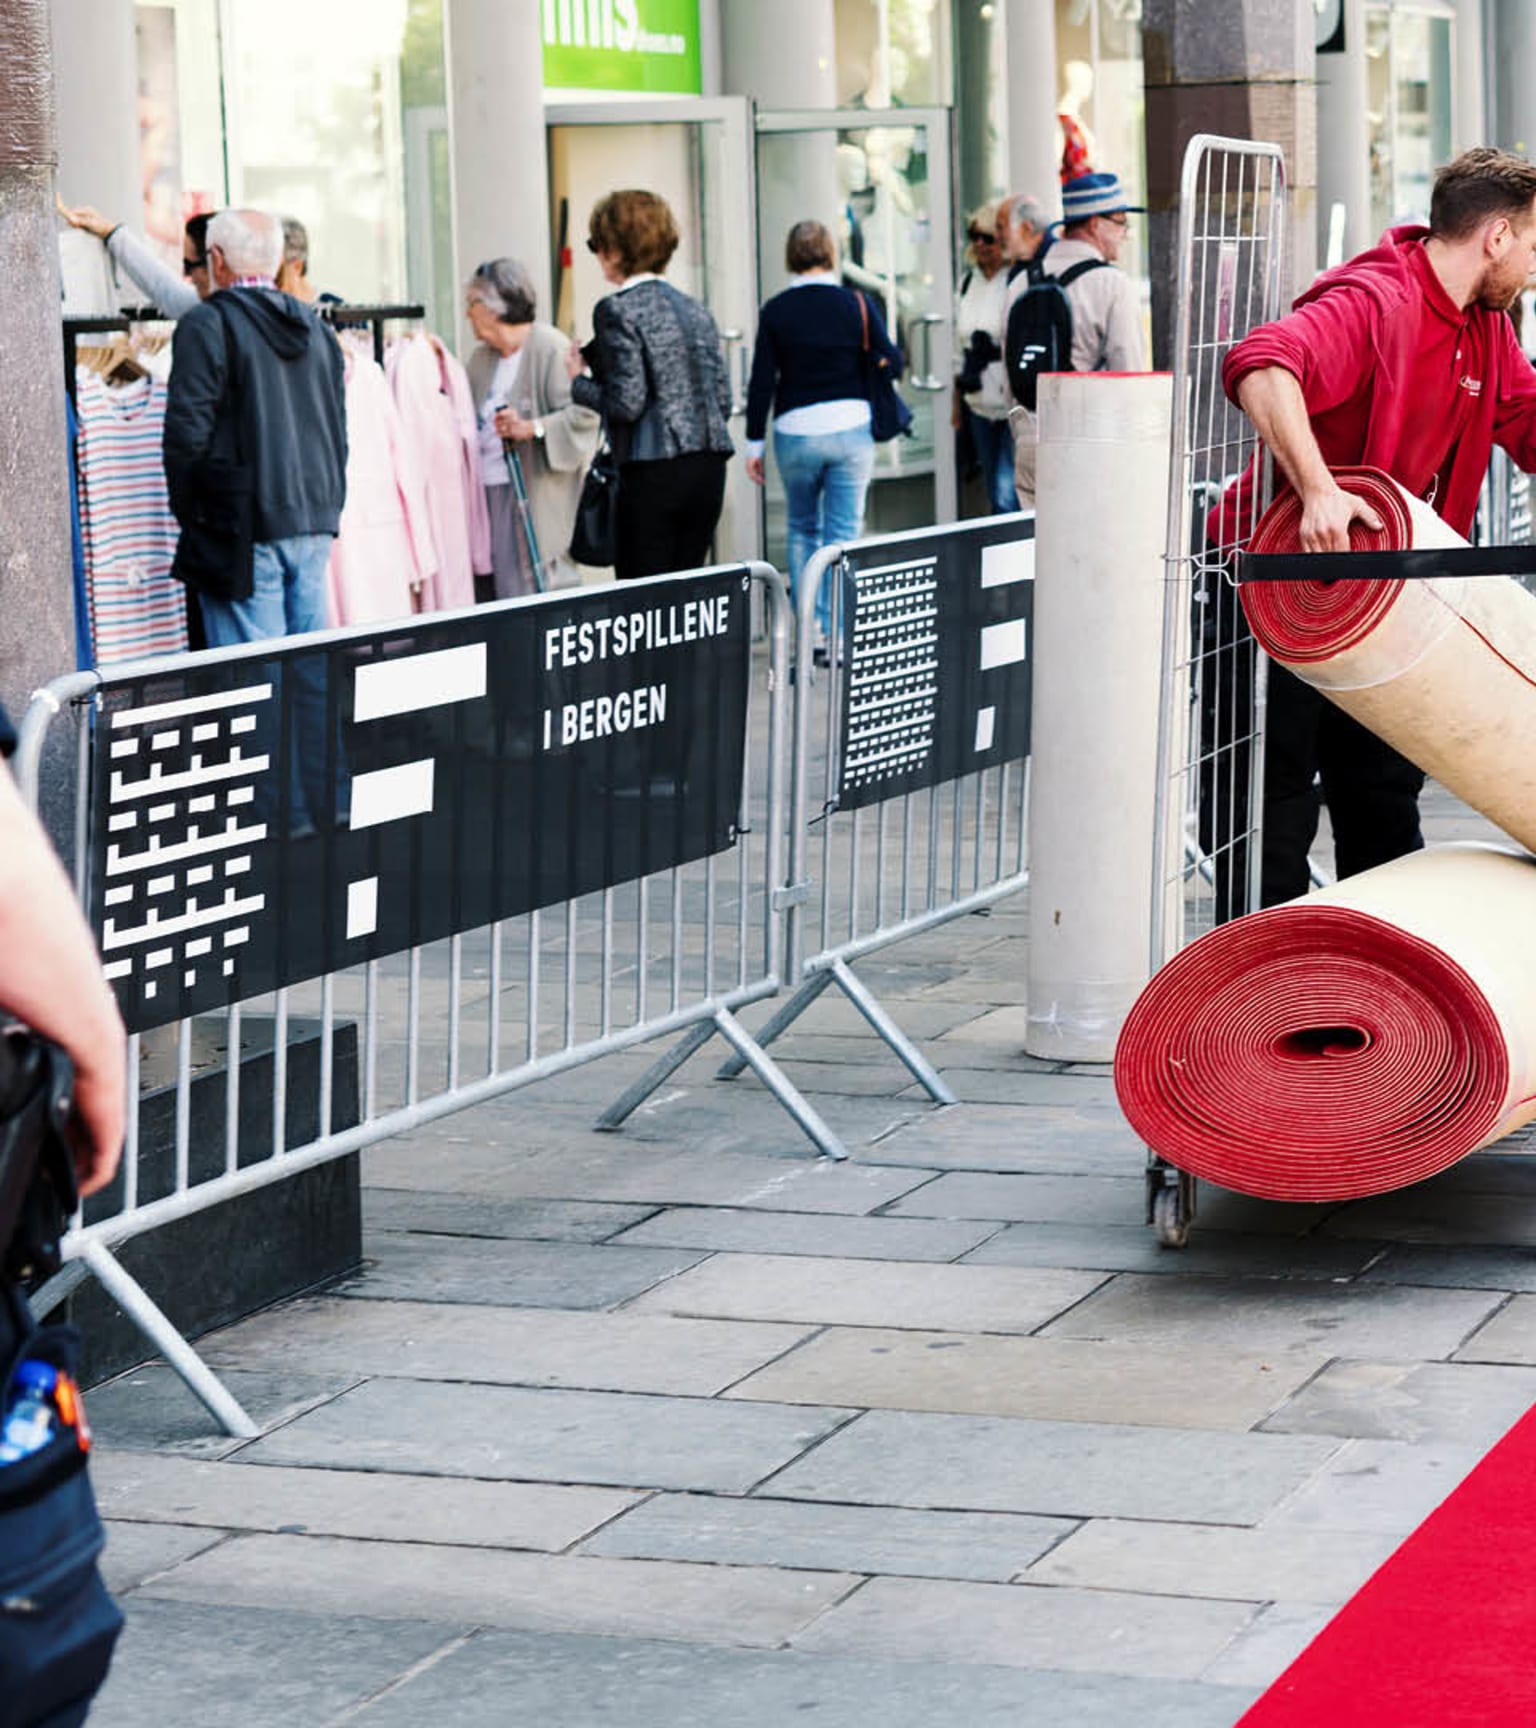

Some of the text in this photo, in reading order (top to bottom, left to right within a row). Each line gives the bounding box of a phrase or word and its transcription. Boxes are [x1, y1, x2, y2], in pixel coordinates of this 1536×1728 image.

[545, 595, 730, 671] FESTSPILLENE
[543, 683, 667, 750] I BERGEN
